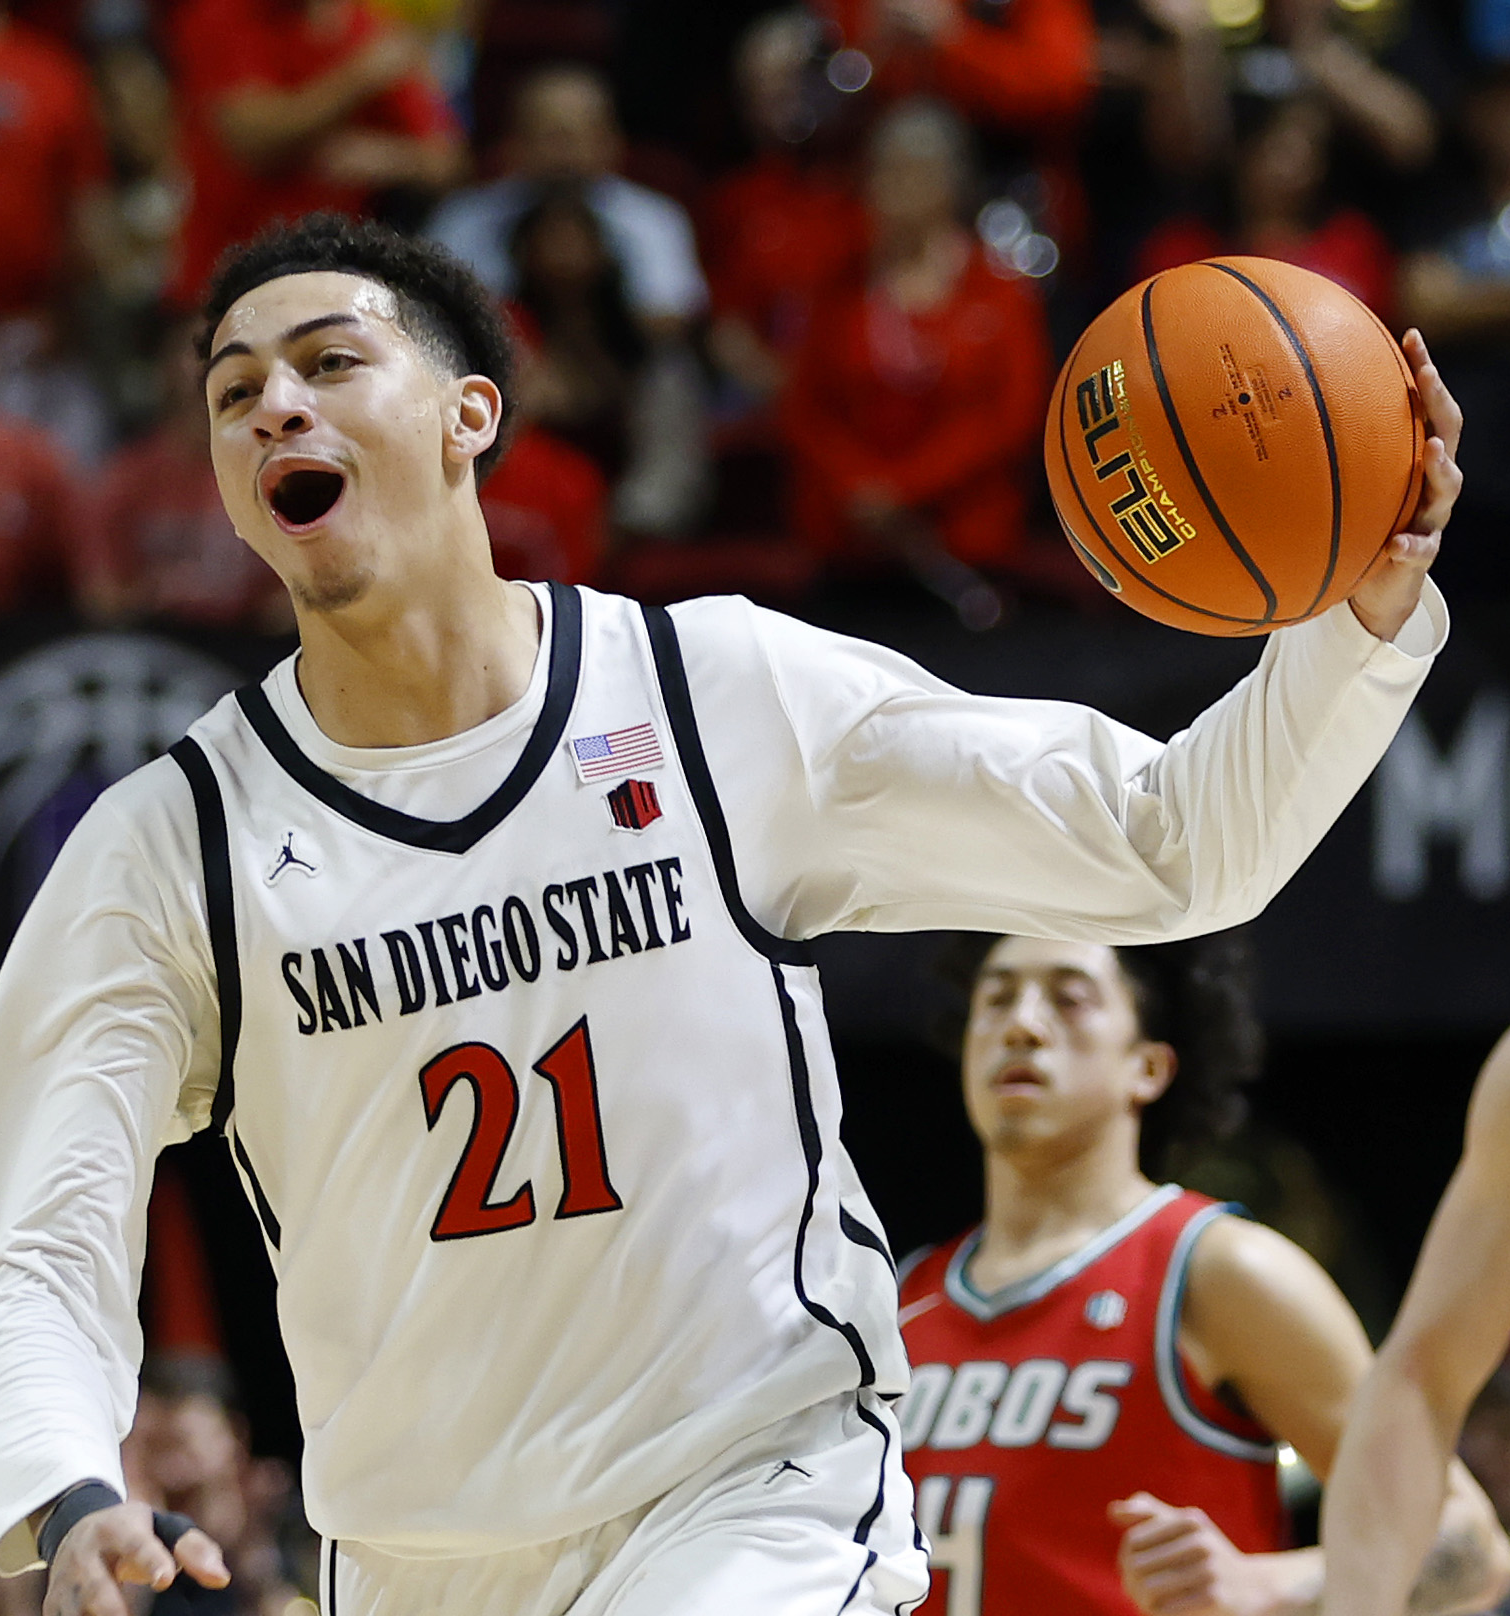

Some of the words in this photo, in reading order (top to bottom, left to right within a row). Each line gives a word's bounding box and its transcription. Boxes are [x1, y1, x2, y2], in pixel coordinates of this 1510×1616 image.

[1076, 364, 1185, 565] ELITE
[280, 936, 384, 1036] SAN
[380, 895, 542, 1016] DIEGO
[541, 856, 692, 972] STATE
[417, 1013, 624, 1242] 21
[896, 1358, 1133, 1452] OBOS
